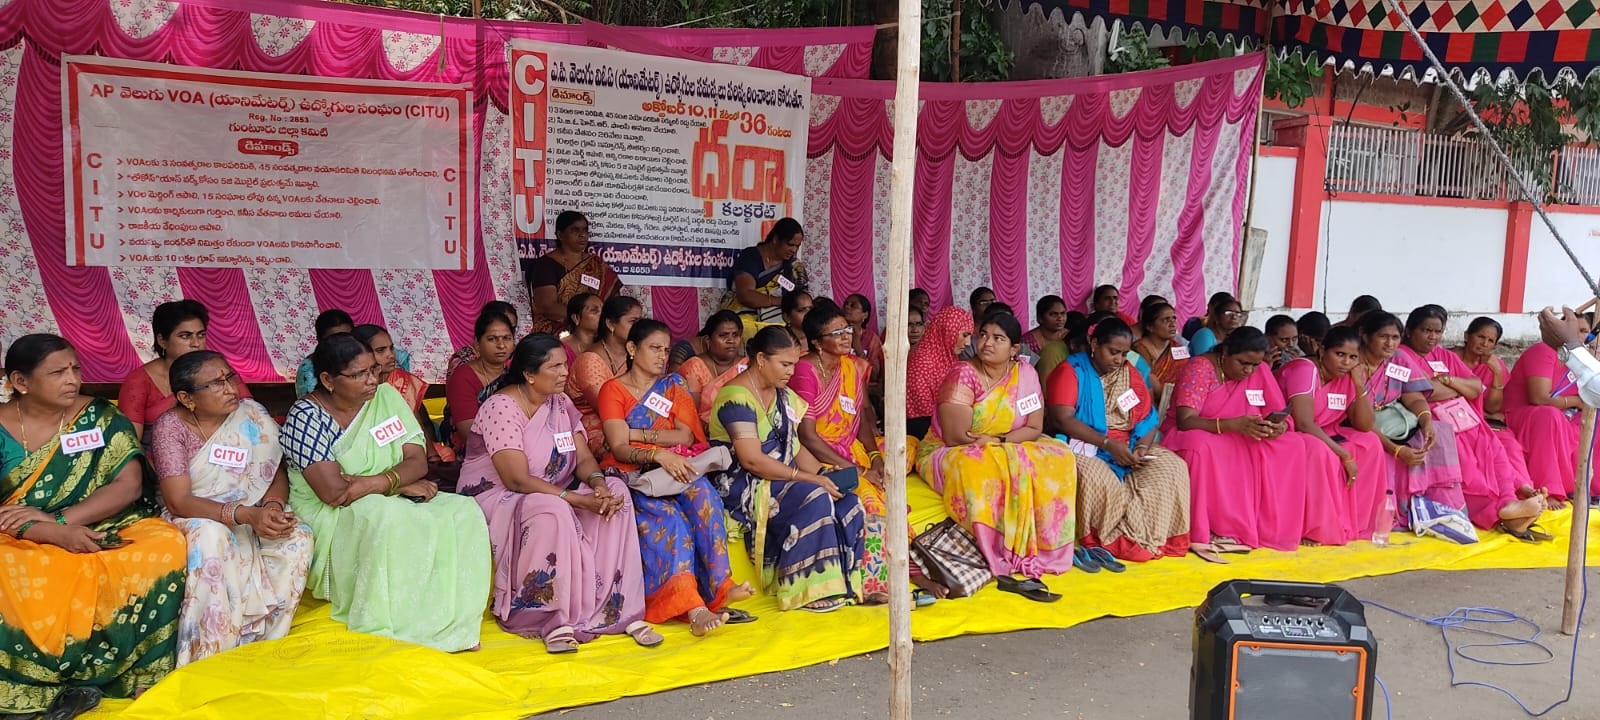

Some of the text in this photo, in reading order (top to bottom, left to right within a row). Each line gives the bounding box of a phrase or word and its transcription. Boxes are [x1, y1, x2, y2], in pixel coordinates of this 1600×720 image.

[569, 61, 594, 85] వెలుగు
[90, 84, 114, 97] AP
[120, 86, 164, 101] వెలుగు
[167, 89, 204, 104] VOA
[299, 97, 356, 117] ఉద్యోగుల
[357, 104, 402, 116] సంఘం
[405, 104, 449, 121] (CITU)
[551, 89, 593, 105] డిమాండ్స్
[229, 122, 276, 134] గుంటూరు
[278, 127, 299, 138] జిల్లా
[740, 111, 767, 134] 36
[161, 159, 168, 167] 3
[258, 163, 271, 171] 45
[202, 192, 214, 200] 15
[722, 202, 776, 223] కలక్టరేట్
[165, 254, 177, 262] 10
[663, 248, 702, 270] ఉద్యోగుల
[702, 250, 735, 269] సంఘం
[583, 276, 598, 286] CITU
[1389, 365, 1409, 378] CITU
[1020, 396, 1037, 410] CITU
[1120, 392, 1137, 408] CITU
[1329, 395, 1346, 406] CITU
[375, 420, 403, 440] CITU
[66, 435, 100, 449] CITU
[556, 436, 574, 448] CITU
[213, 447, 246, 463] CITU
